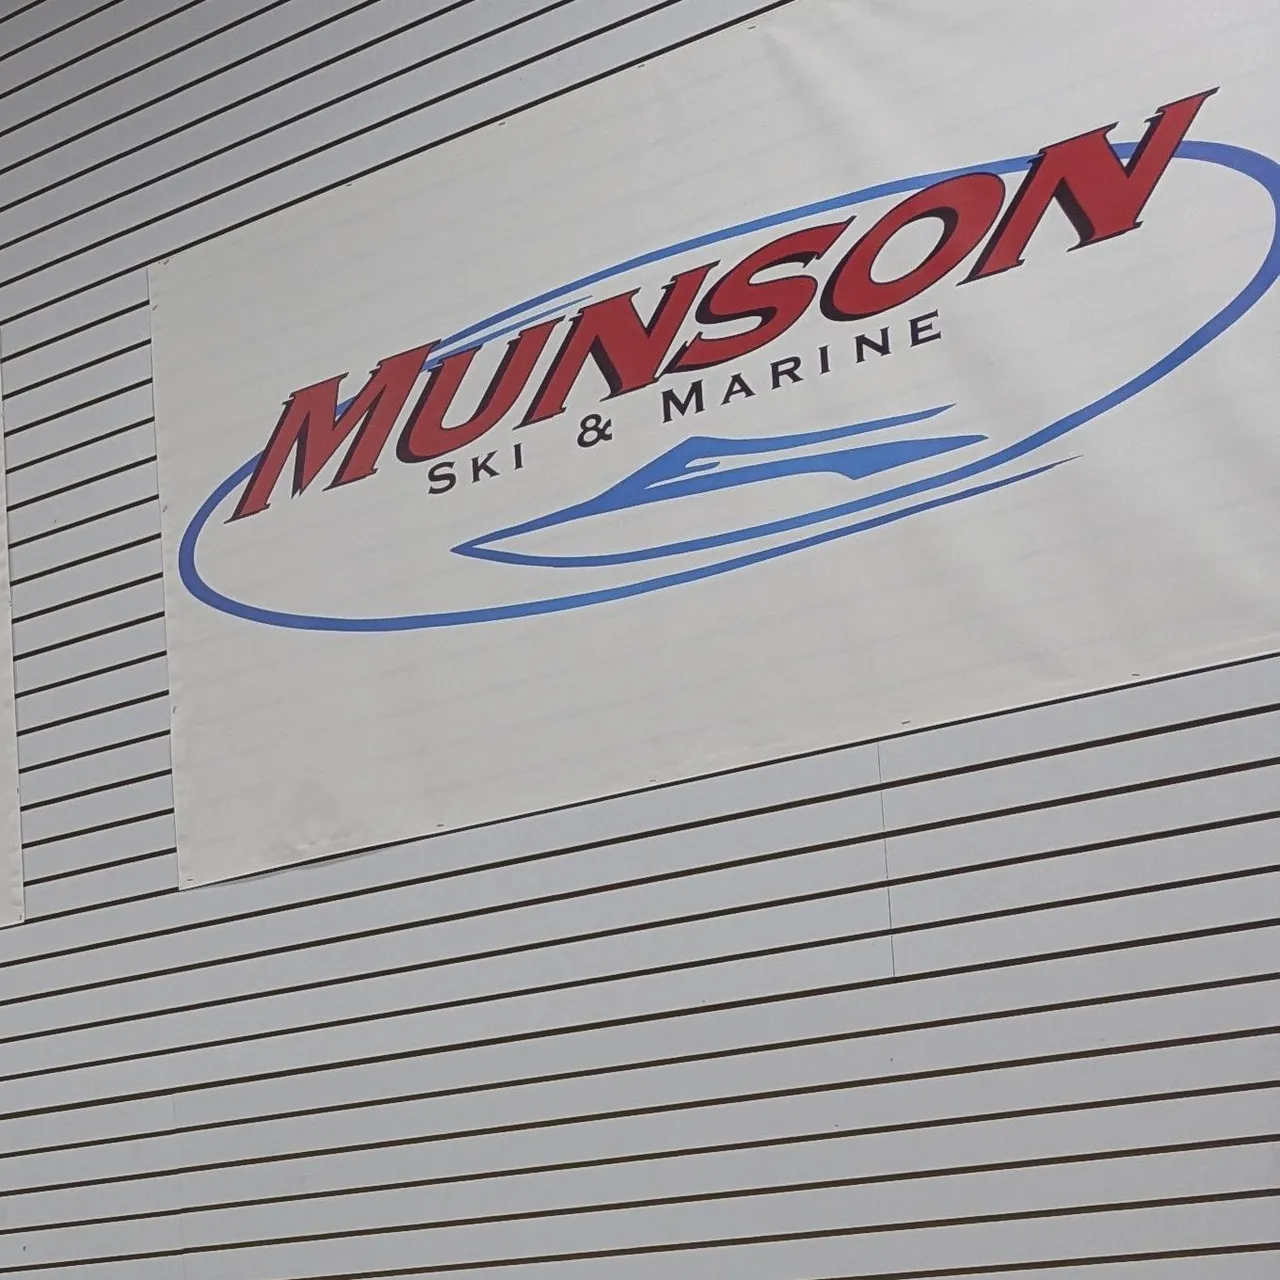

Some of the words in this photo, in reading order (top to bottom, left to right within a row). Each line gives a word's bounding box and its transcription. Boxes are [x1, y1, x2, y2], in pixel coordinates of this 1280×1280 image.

[225, 87, 1219, 523] MUNSON
[427, 442, 524, 496] SKI
[576, 412, 613, 449] &
[661, 309, 942, 424] MARINE
